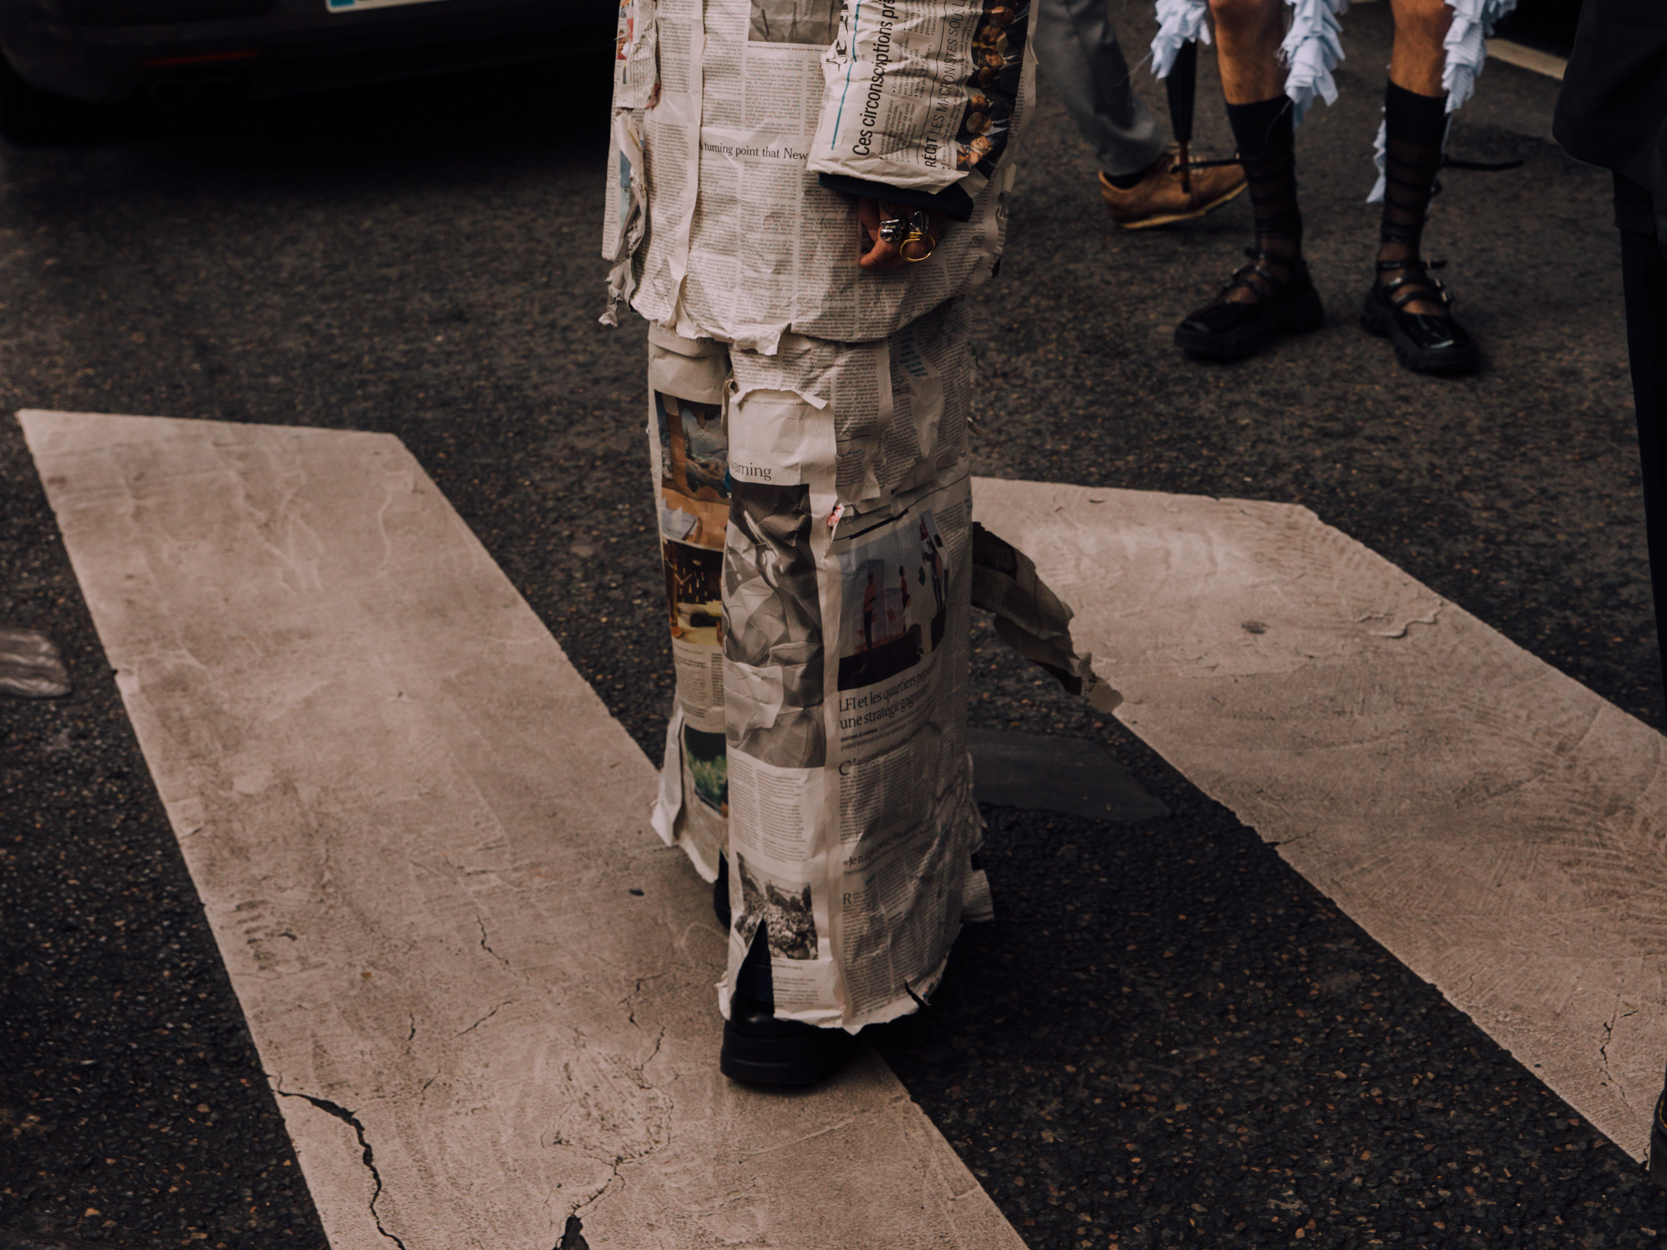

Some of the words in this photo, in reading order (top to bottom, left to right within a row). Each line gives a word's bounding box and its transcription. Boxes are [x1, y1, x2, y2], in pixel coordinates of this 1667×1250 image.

[860, 21, 895, 127] circonscriptions
[922, 138, 938, 168] RÉCIT
[930, 113, 944, 138] LES
[937, 37, 958, 113] MACRONISTES
[948, 9, 967, 34] SOUS
[704, 142, 734, 157] turning
[735, 145, 759, 158] point
[762, 146, 780, 159] that
[783, 147, 809, 160] New
[853, 130, 873, 157] Ces
[836, 695, 858, 713] LFI
[855, 694, 870, 708] et
[867, 689, 884, 705] les
[838, 713, 864, 730] une
[861, 698, 900, 725] stratégie
